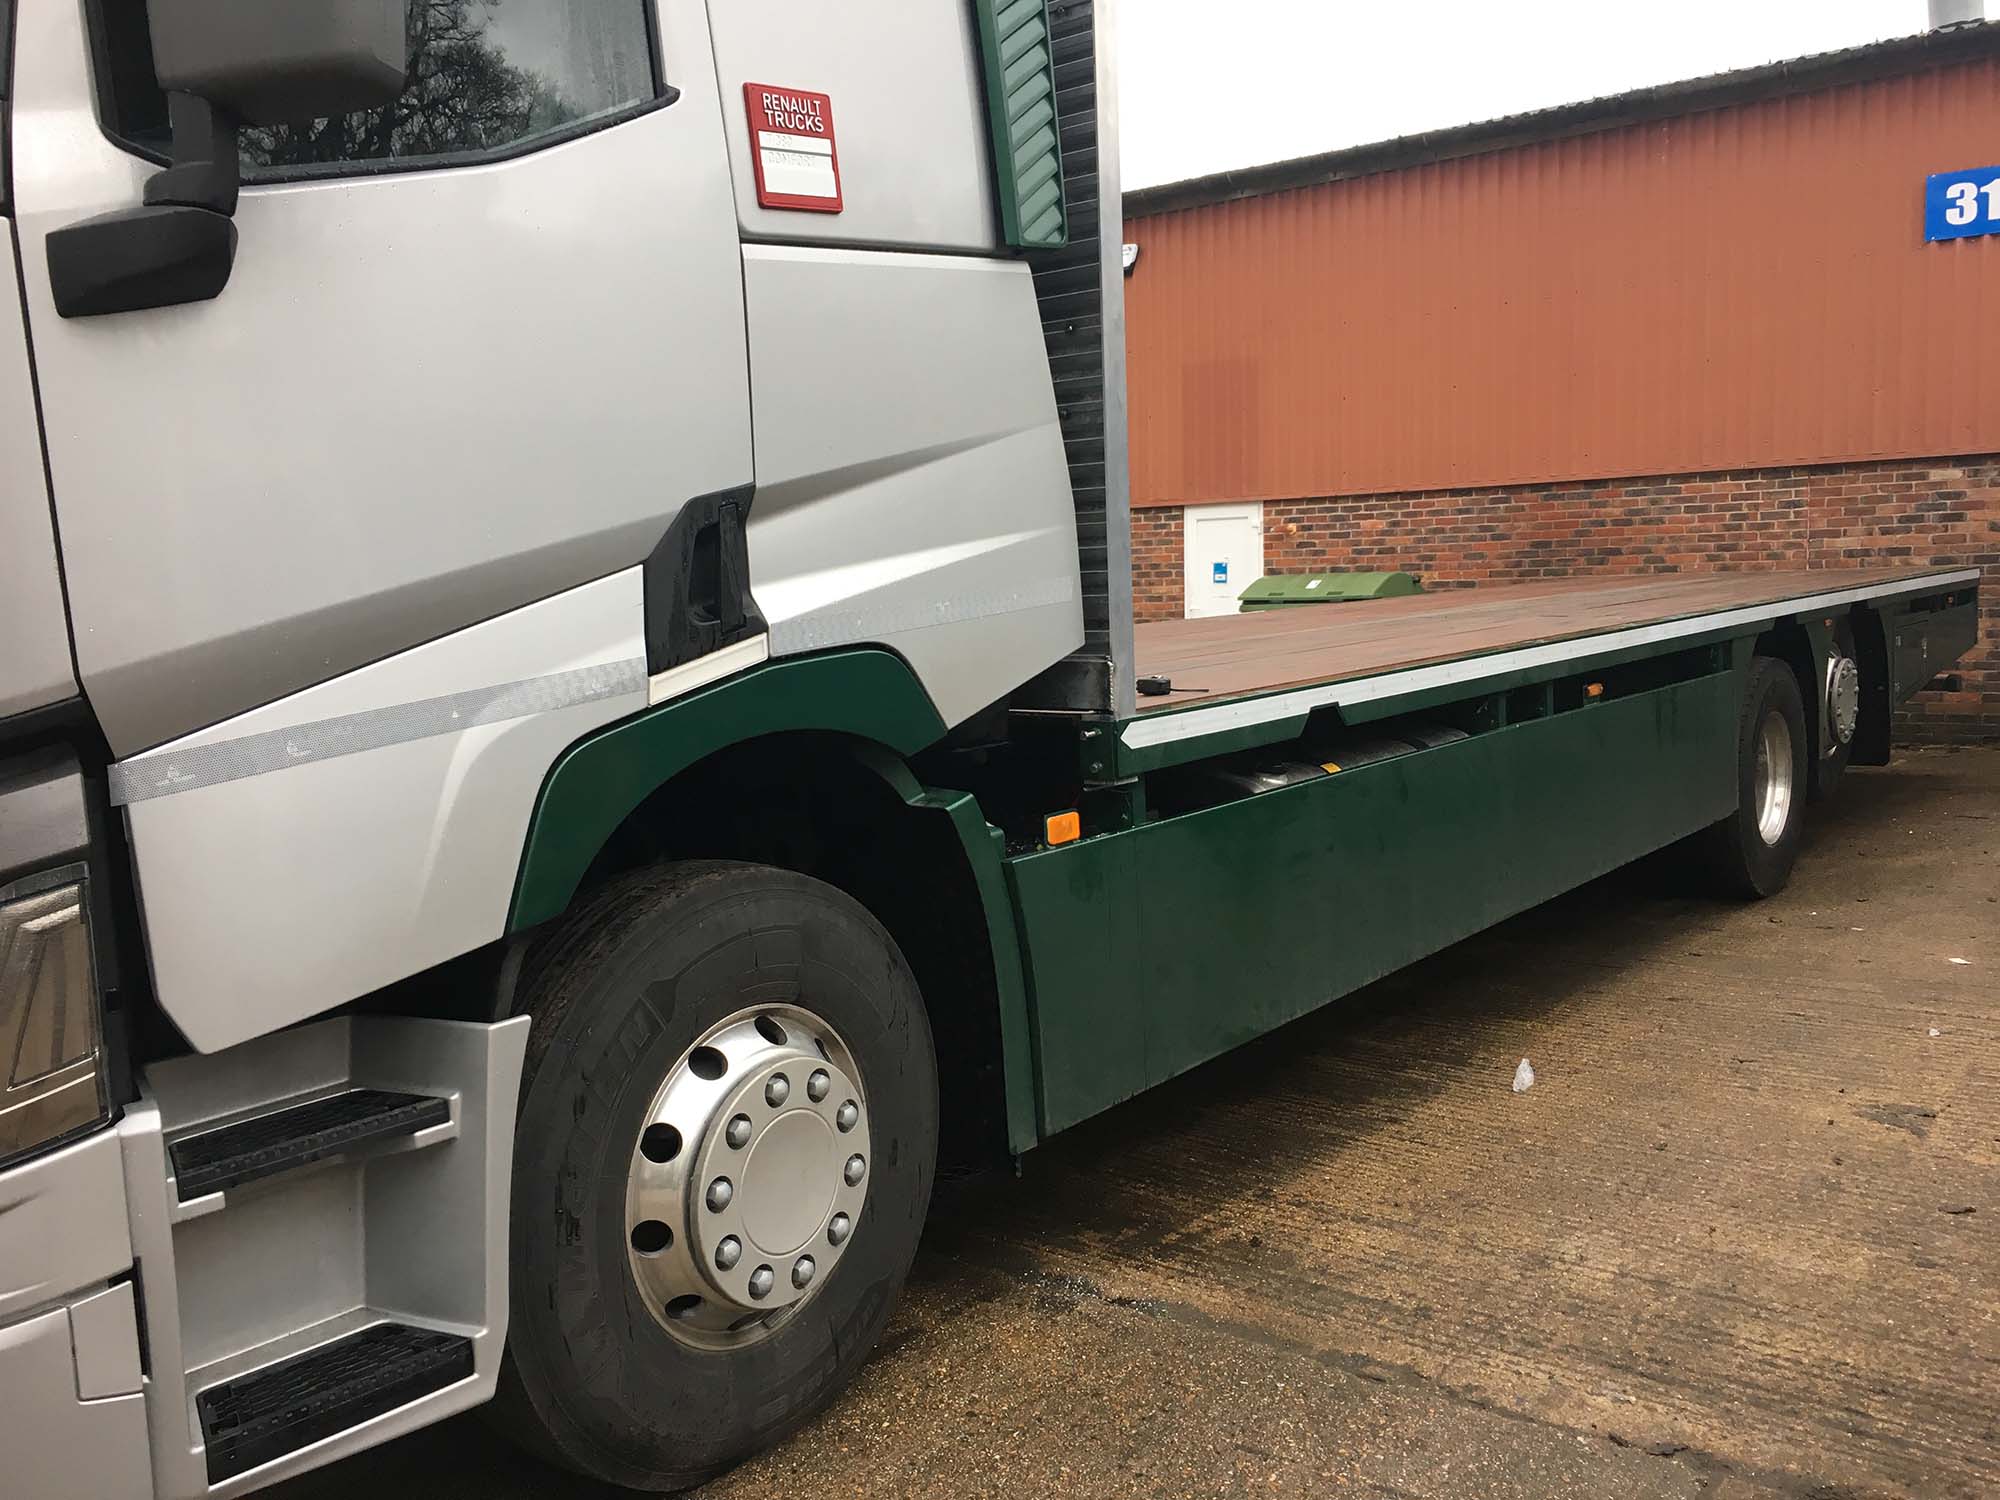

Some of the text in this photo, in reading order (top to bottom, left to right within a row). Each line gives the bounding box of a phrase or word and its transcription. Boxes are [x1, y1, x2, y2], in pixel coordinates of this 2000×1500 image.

[763, 93, 821, 116] RENAULT
[765, 110, 825, 132] TRUCKS
[1945, 178, 2000, 225] 31
